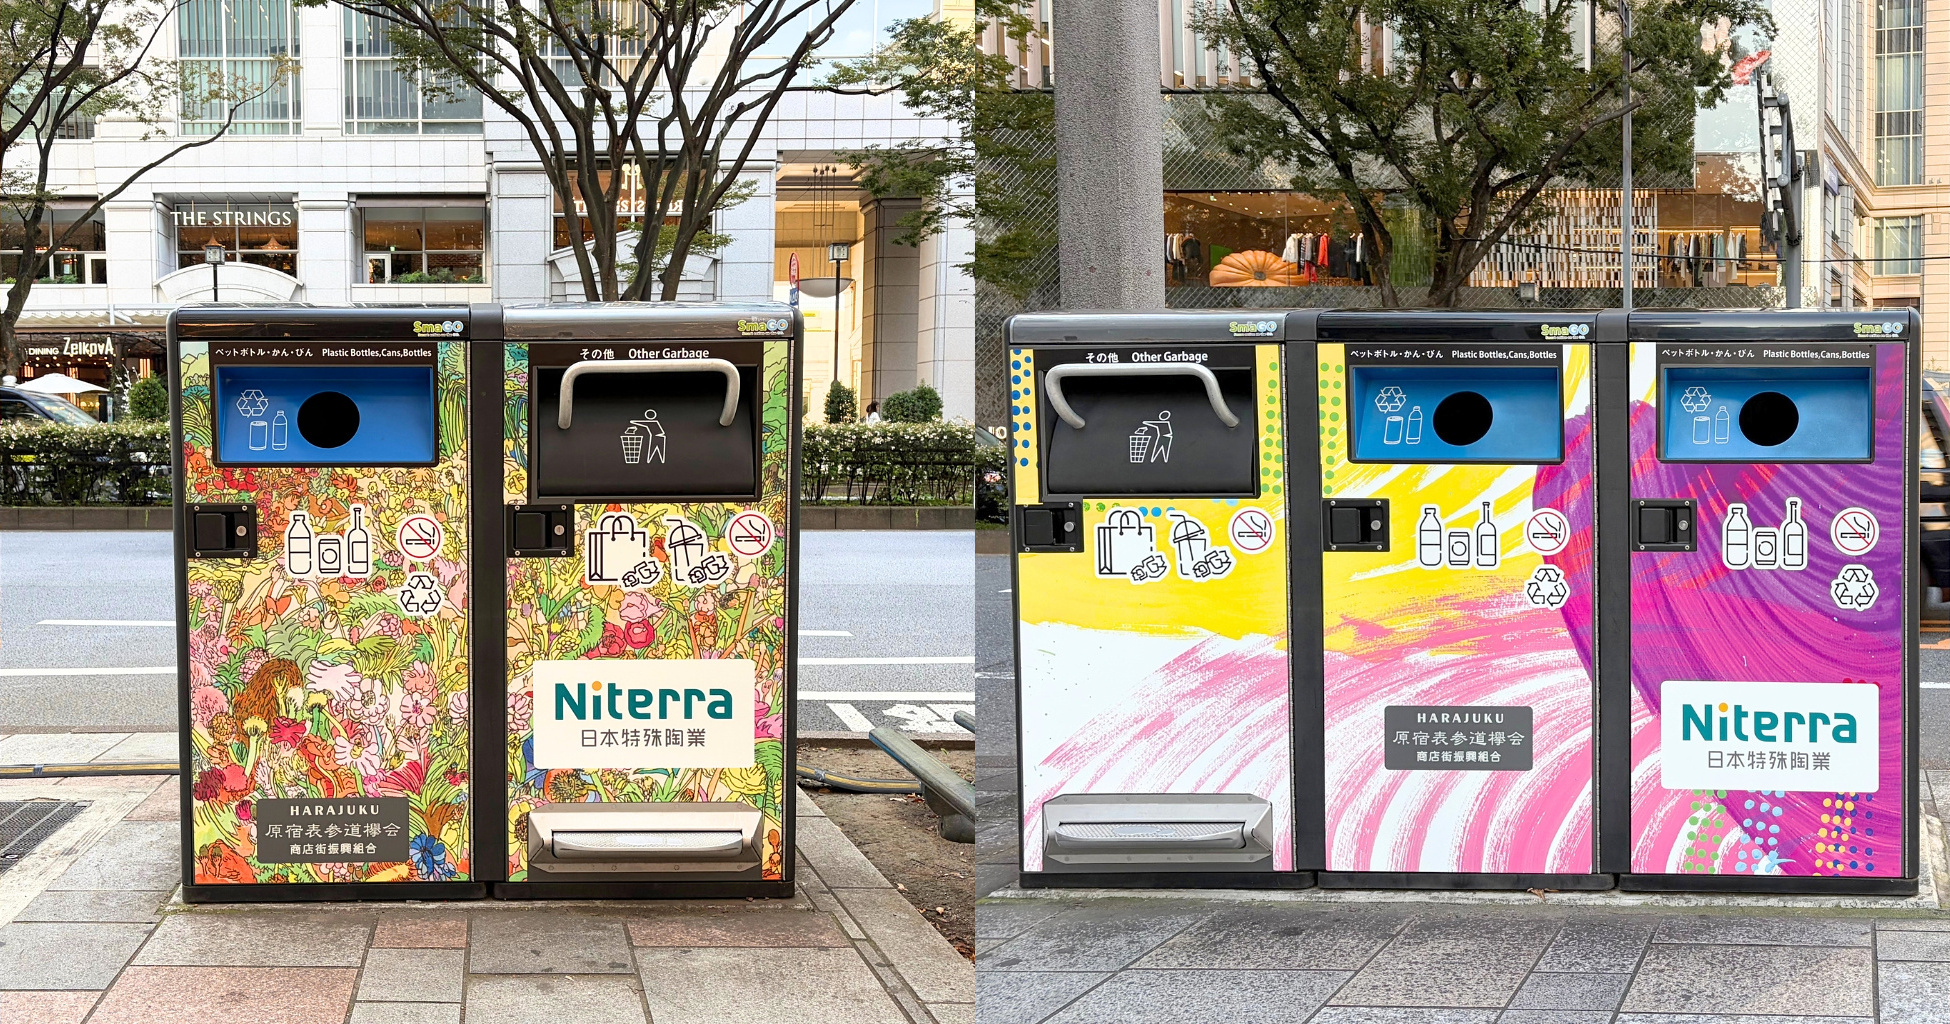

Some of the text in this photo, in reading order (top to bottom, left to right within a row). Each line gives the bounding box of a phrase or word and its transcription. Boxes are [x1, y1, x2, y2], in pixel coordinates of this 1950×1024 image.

[170, 211, 292, 226] THE STRINGS
[413, 320, 464, 333] SmaGO
[737, 319, 789, 332] SmaGO
[1229, 321, 1277, 333] SmaGO
[1540, 323, 1590, 336] SmaGO
[1853, 322, 1904, 334] SmaGO
[28, 347, 59, 356] DINING
[215, 348, 313, 357] ペットボトル・かん・びん
[322, 348, 349, 357] Plastic
[579, 347, 710, 360] その他 Other Garbage
[1085, 351, 1208, 364] その他 Other Garbage
[1350, 349, 1444, 358] ペットボトル・かん・びん
[1452, 350, 1477, 359] Plastic
[1661, 349, 1755, 358] ペットボトル・かん・びん
[1763, 349, 1789, 358] Plastic
[554, 680, 733, 721] Niterra
[1417, 712, 1504, 724] HARAJUKU
[1682, 702, 1857, 744] Niterra
[581, 728, 706, 748] 日本特殊陶業
[1392, 730, 1525, 746] 原宿表参道欅会
[1416, 751, 1502, 763] 商店街振興組合
[1708, 750, 1831, 771] 日本特殊陶業
[290, 804, 380, 816] HARAJUKU
[264, 822, 401, 839] 原宿表参道欅会
[290, 843, 377, 855] 商店街振興組合
